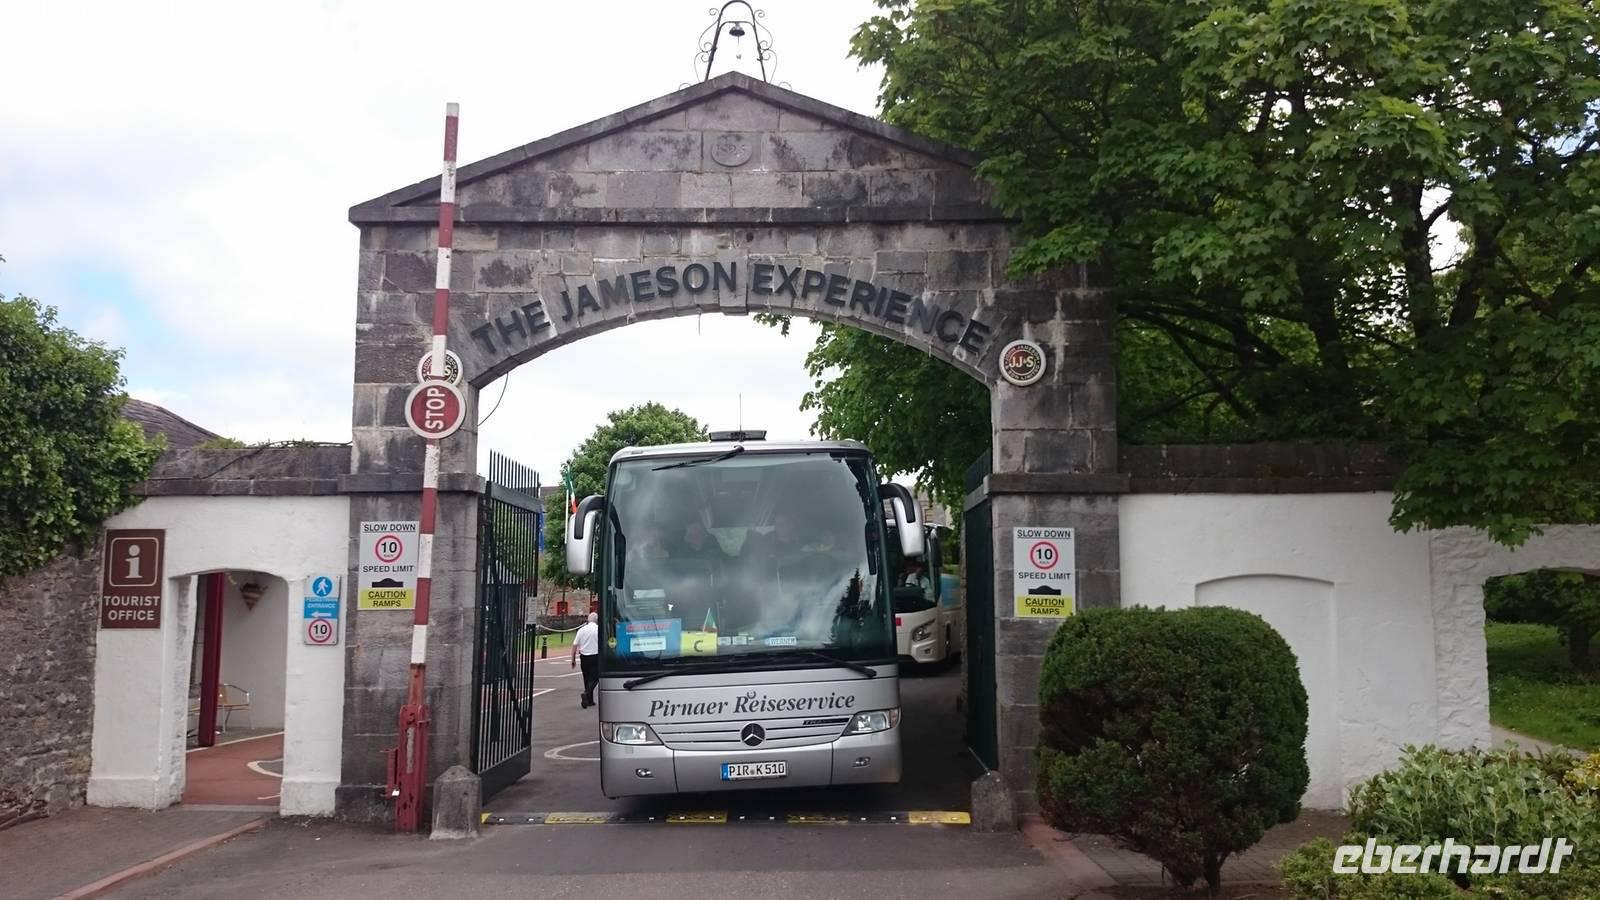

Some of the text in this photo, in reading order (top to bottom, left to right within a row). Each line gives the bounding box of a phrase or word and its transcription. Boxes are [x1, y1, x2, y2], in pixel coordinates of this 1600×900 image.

[470, 261, 992, 357] THE JAMESON EXPERIENCE
[424, 387, 446, 430] STOP
[363, 523, 416, 532] SLOW DOWN
[1017, 529, 1071, 538] SLOW DOWN
[381, 541, 398, 553] 10
[1036, 548, 1053, 560] 10
[362, 565, 414, 573] SPEED LIMIT
[1018, 571, 1071, 580] SPEED LIMIT
[367, 590, 407, 598] CAUTION
[103, 595, 161, 607] TOURIST
[1025, 598, 1065, 615] CAUTION RAMPS
[107, 609, 155, 621] OFFICE
[313, 624, 328, 635] 10
[693, 639, 704, 653] C
[648, 690, 856, 718] Pirnaer Reiseservice
[728, 765, 750, 777] PIR
